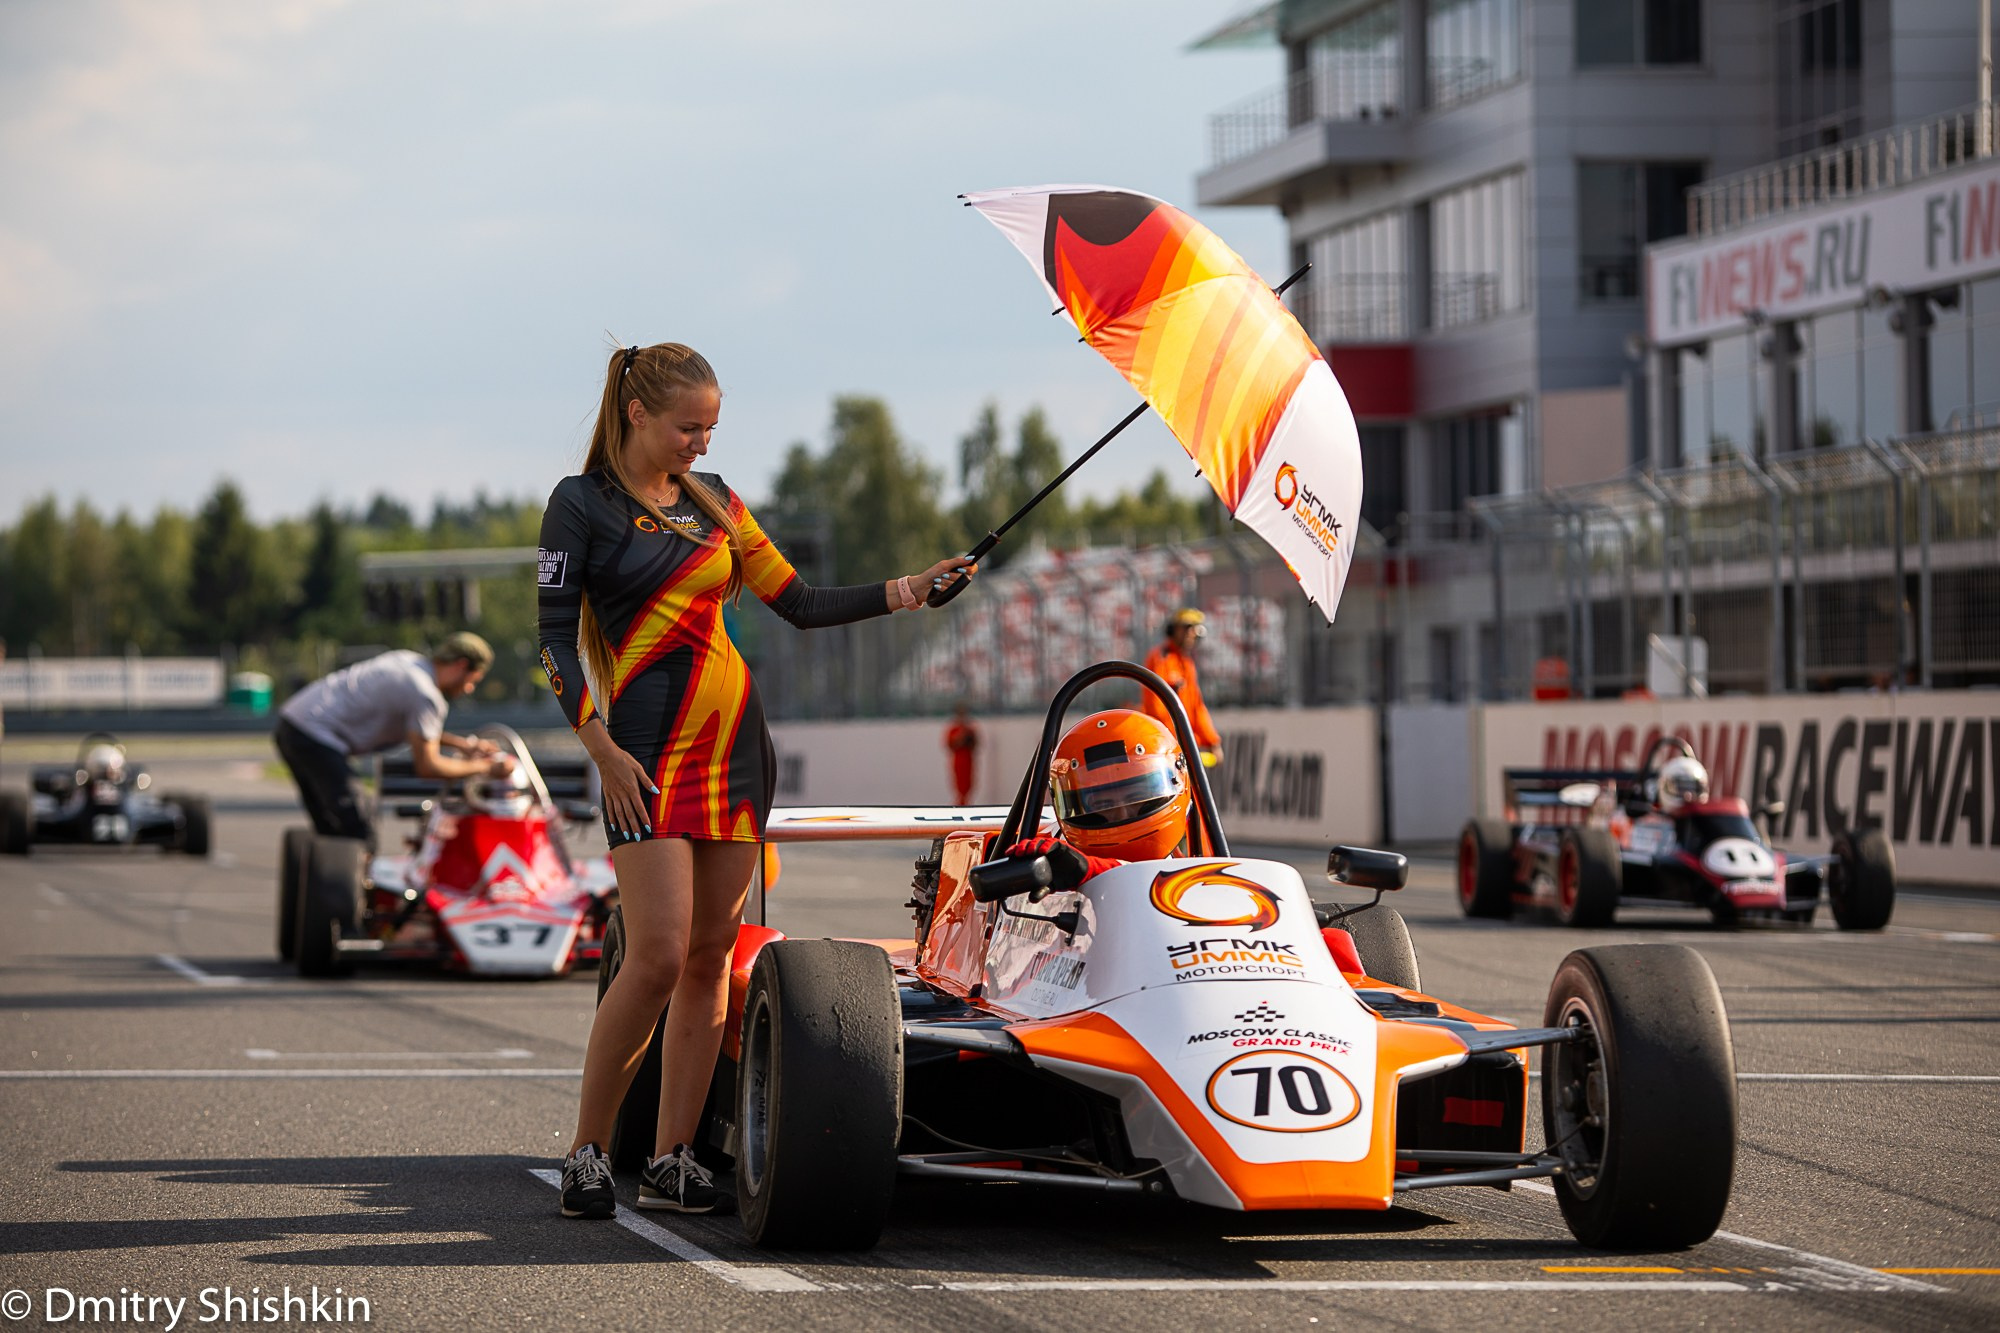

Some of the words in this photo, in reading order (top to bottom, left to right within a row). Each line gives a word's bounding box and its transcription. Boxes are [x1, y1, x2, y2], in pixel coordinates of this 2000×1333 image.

[1668, 211, 1872, 329] F1NEWS.RU
[1300, 484, 1344, 538] УГМК
[660, 522, 700, 531] UMC
[1295, 498, 1338, 551] UMMC
[539, 551, 563, 562] USSIAN
[538, 561, 558, 573] ACING
[538, 572, 553, 584] ROUP
[1750, 714, 2000, 847] RACEWA
[473, 923, 553, 948] 37
[1166, 938, 1299, 958] УГМК
[1170, 951, 1304, 970] UMMC
[1175, 965, 1307, 982] МОТОРСПОРТ
[1187, 1028, 1278, 1045] MOSCOW
[1283, 1028, 1353, 1050] CLASSIC
[1232, 1038, 1302, 1048] GRAND
[1310, 1041, 1349, 1056] PRIX
[1230, 1065, 1332, 1118] 70
